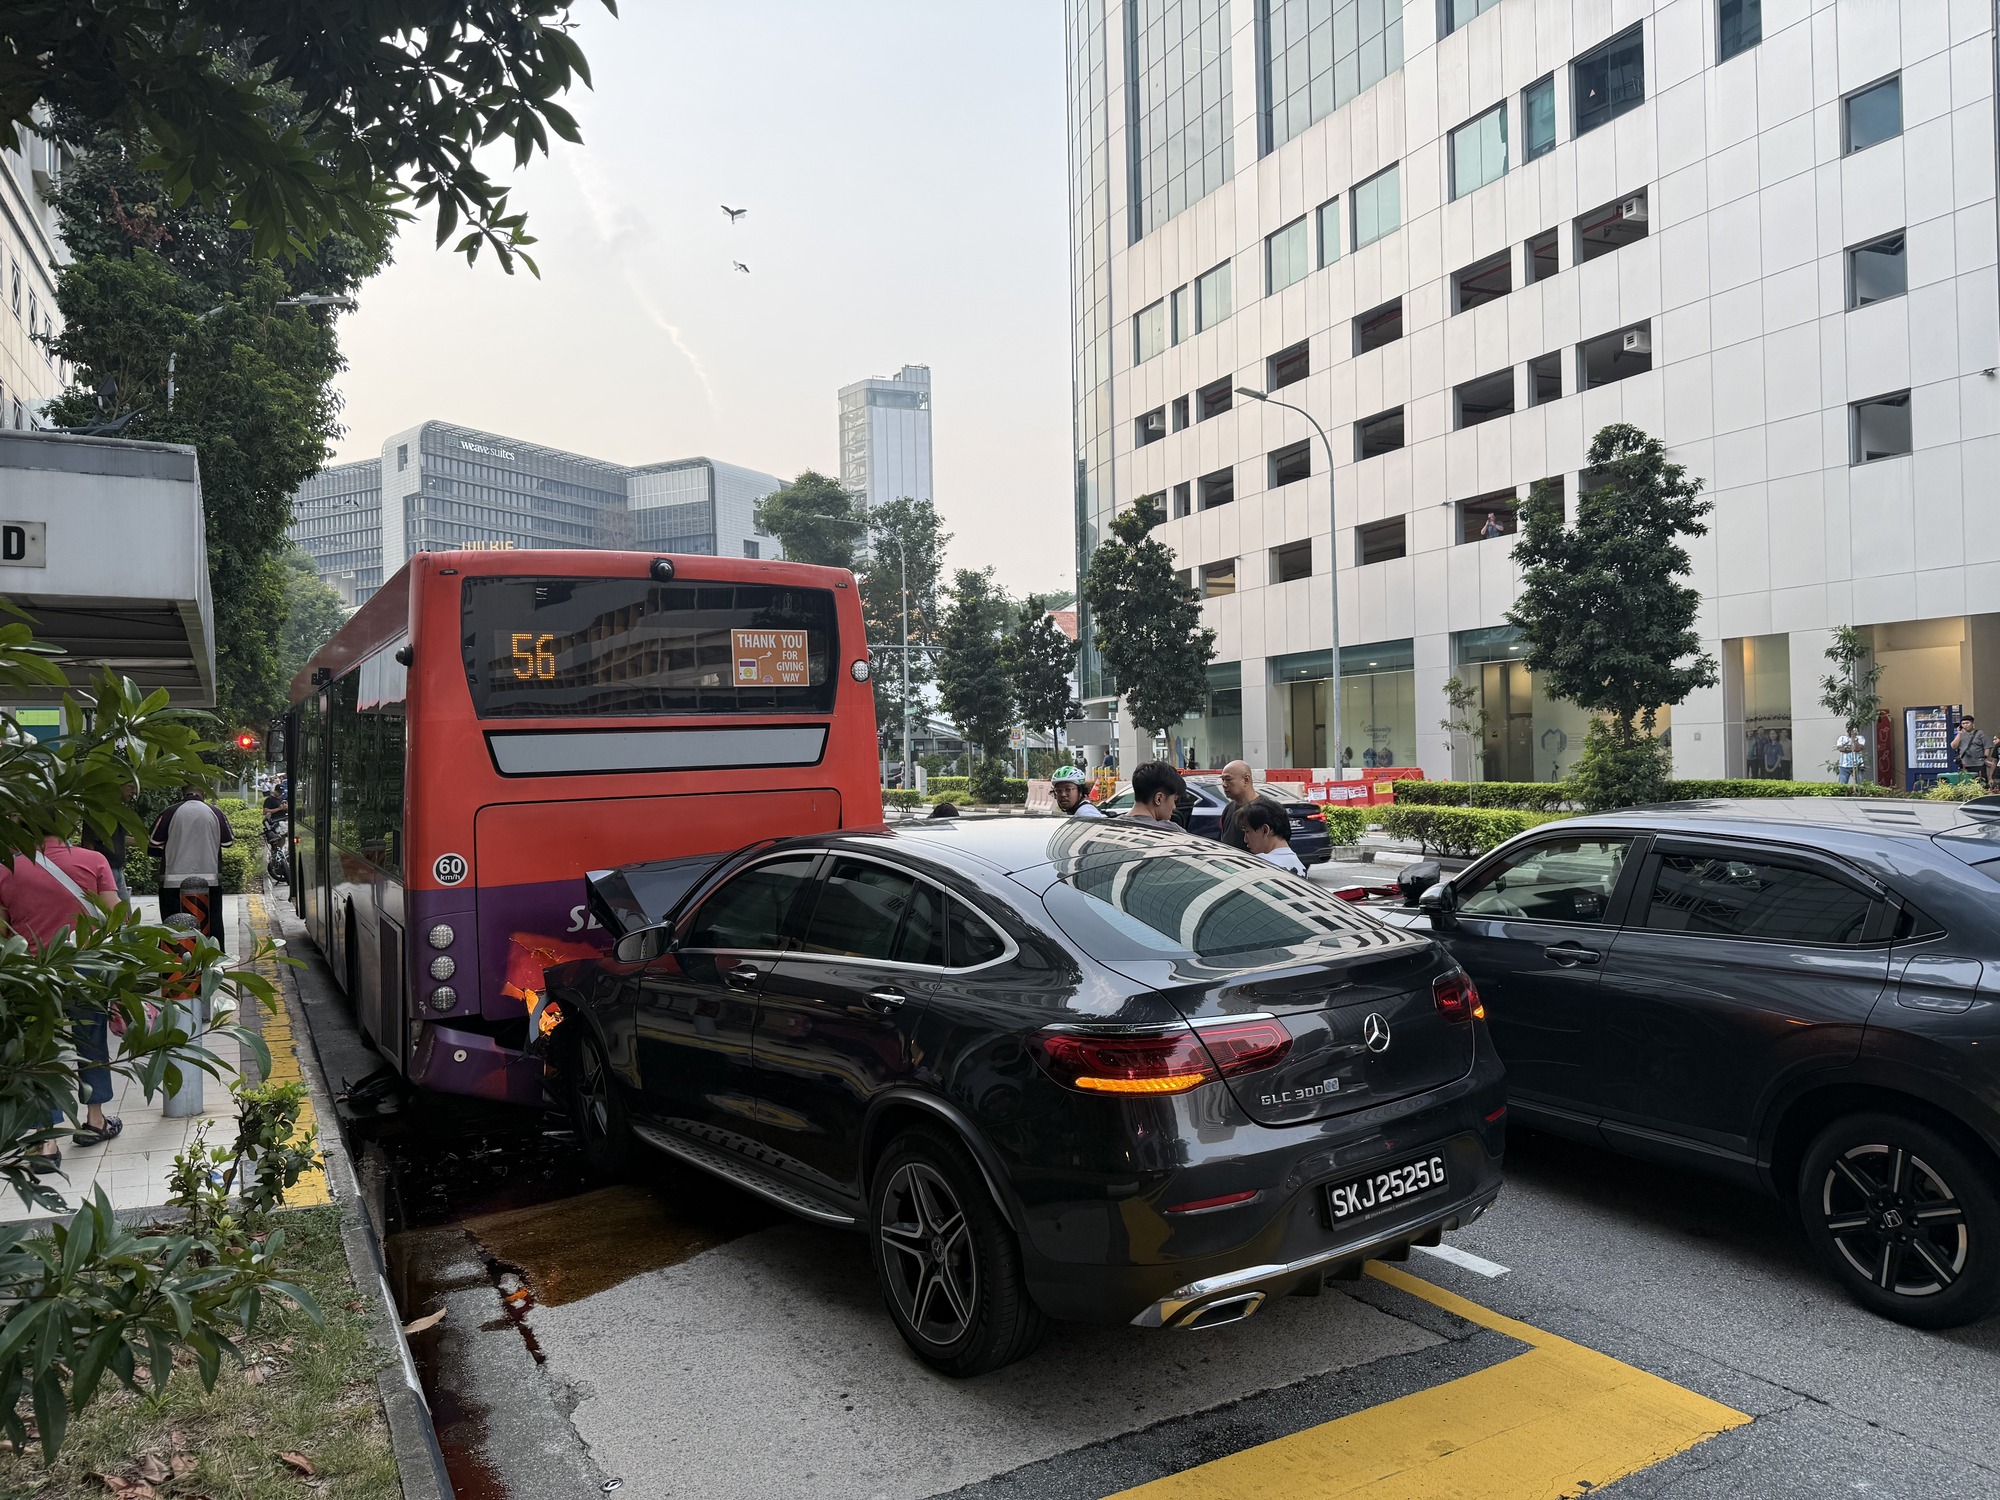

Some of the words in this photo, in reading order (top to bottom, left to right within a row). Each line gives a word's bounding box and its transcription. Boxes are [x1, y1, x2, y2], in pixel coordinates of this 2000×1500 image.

[460, 440, 490, 455] weave
[490, 447, 515, 460] suites
[737, 634, 776, 648] THANK
[780, 634, 803, 648] YOU
[512, 633, 555, 679] 56
[782, 650, 798, 660] FOR
[776, 661, 804, 671] GIVING
[782, 673, 800, 682] WAY
[439, 859, 461, 874] 60
[1261, 1091, 1291, 1105] GLC
[1295, 1085, 1323, 1099] 300
[1332, 1157, 1444, 1217] SKJ2525G
